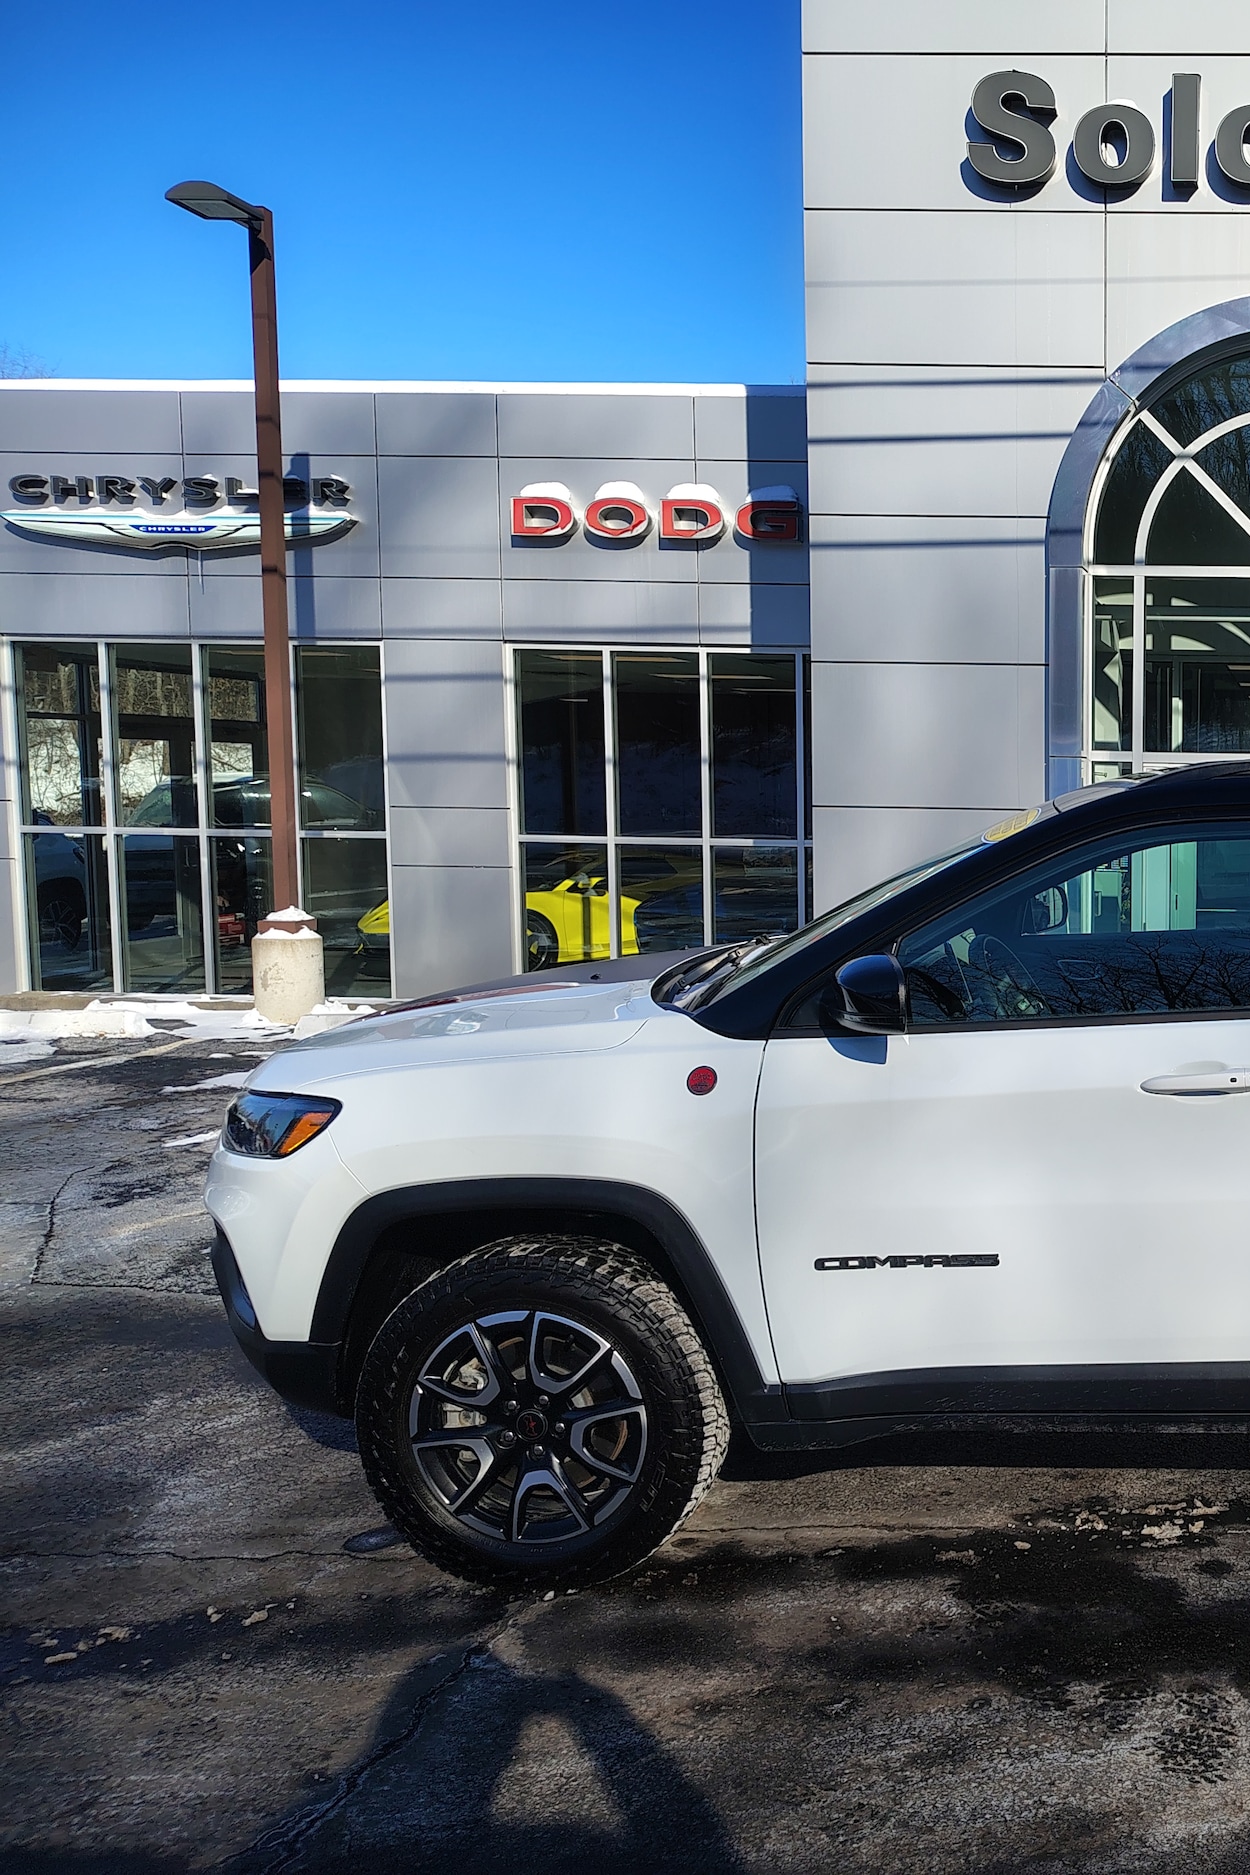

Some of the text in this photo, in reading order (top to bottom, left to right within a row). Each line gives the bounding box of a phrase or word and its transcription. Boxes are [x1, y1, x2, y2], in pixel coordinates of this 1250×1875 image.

[8, 474, 352, 505] CHRYSLER
[510, 496, 804, 544] DODG
[813, 1253, 1000, 1271] COMPASS
